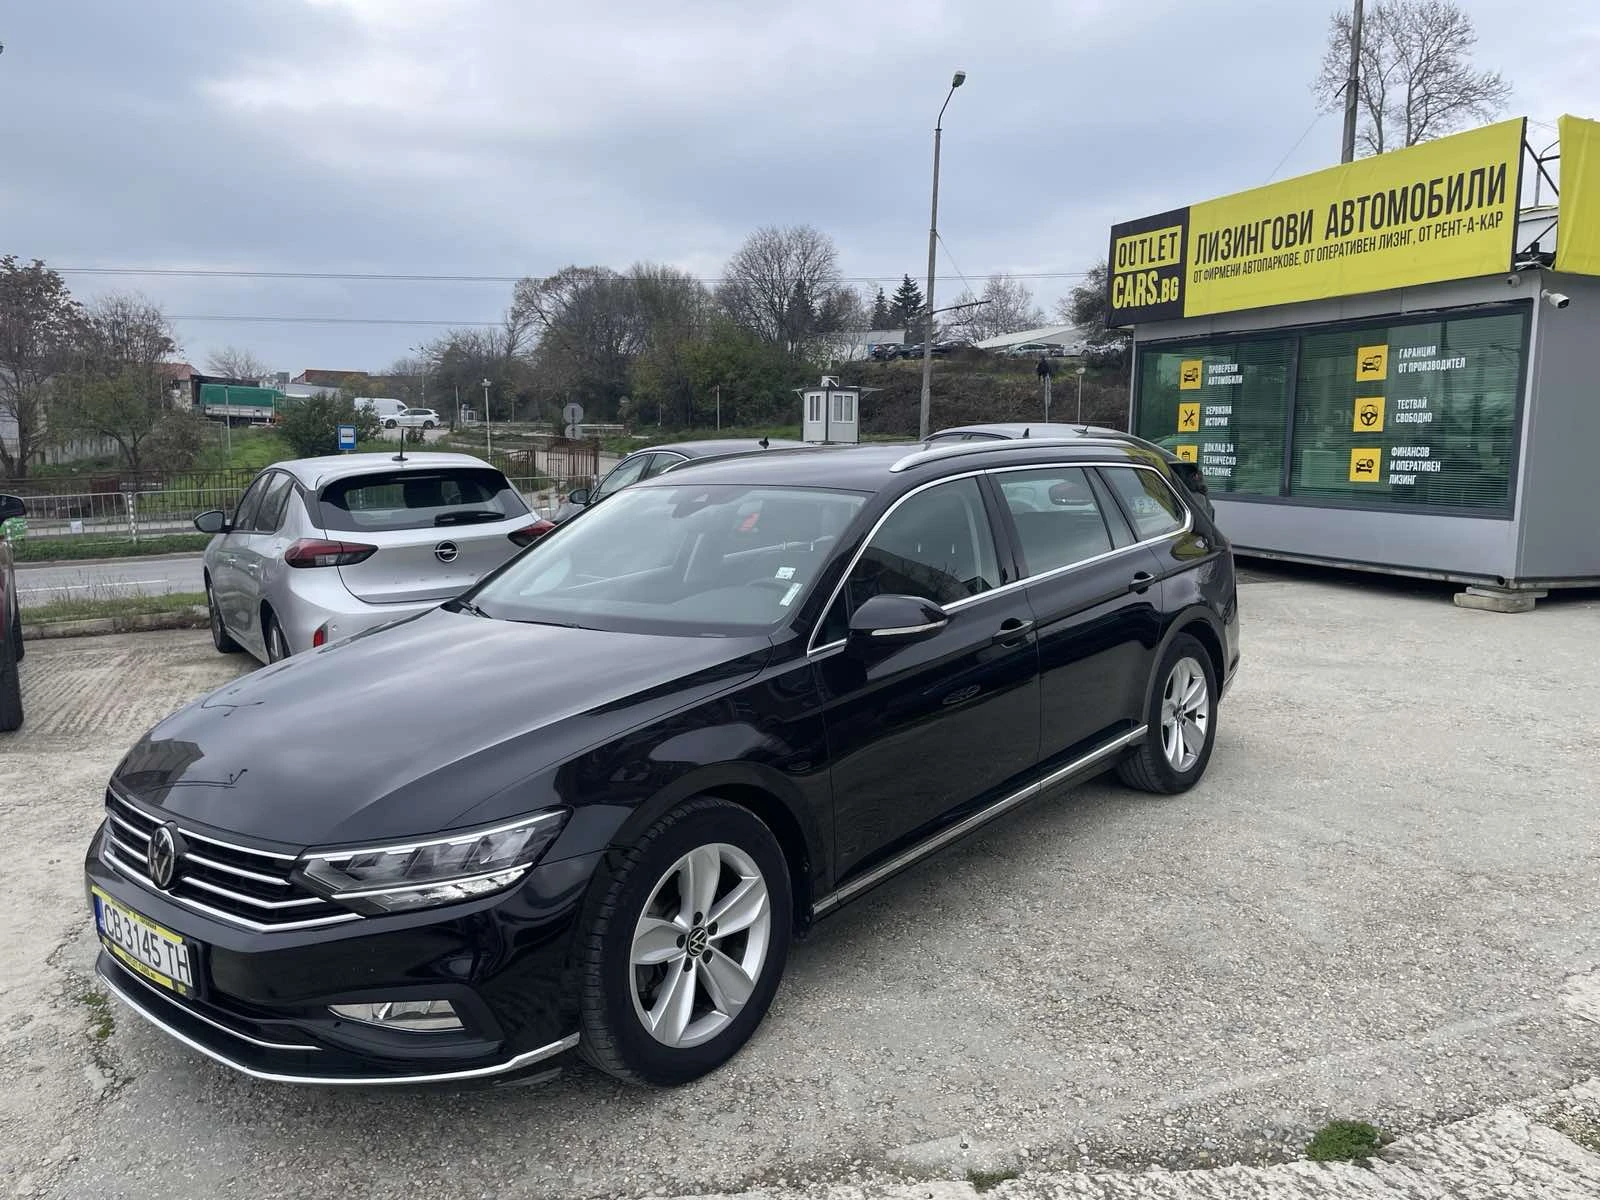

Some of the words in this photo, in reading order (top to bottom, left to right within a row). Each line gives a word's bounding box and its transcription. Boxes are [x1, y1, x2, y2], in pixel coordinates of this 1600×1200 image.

[1194, 208, 1314, 266] ЛИЗИНГОВИ
[1324, 162, 1507, 241] АВТОМОБИЛИ
[1118, 231, 1178, 268] OUTLET
[1193, 269, 1204, 284] ОТ
[1203, 261, 1241, 281] ФИРМЕНИ
[1303, 248, 1316, 264] ОТ
[1316, 236, 1377, 262] ОПЕРАТИВЕН
[1418, 224, 1433, 243] ОТ
[1434, 210, 1504, 240] РЕНТ-А-КАР
[1112, 270, 1180, 310] CARS.BG
[1399, 345, 1437, 359] ГАРАНЦИЯ
[1398, 362, 1408, 374] ОТ
[1408, 357, 1466, 373] ПРОИЗВОДИТЕЛ
[1397, 396, 1428, 410] ТЕСТВАЙ
[1395, 412, 1433, 424] СВОБОДНО
[1391, 446, 1430, 457] ФИНАНСОВ
[1203, 455, 1237, 466] ТЕХНИЧЕСКО
[1390, 460, 1396, 471] И
[1396, 460, 1441, 472] ОПЕРАТИВЕН
[1389, 474, 1417, 486] ЛИЗИНГ
[124, 916, 162, 968] 3145
